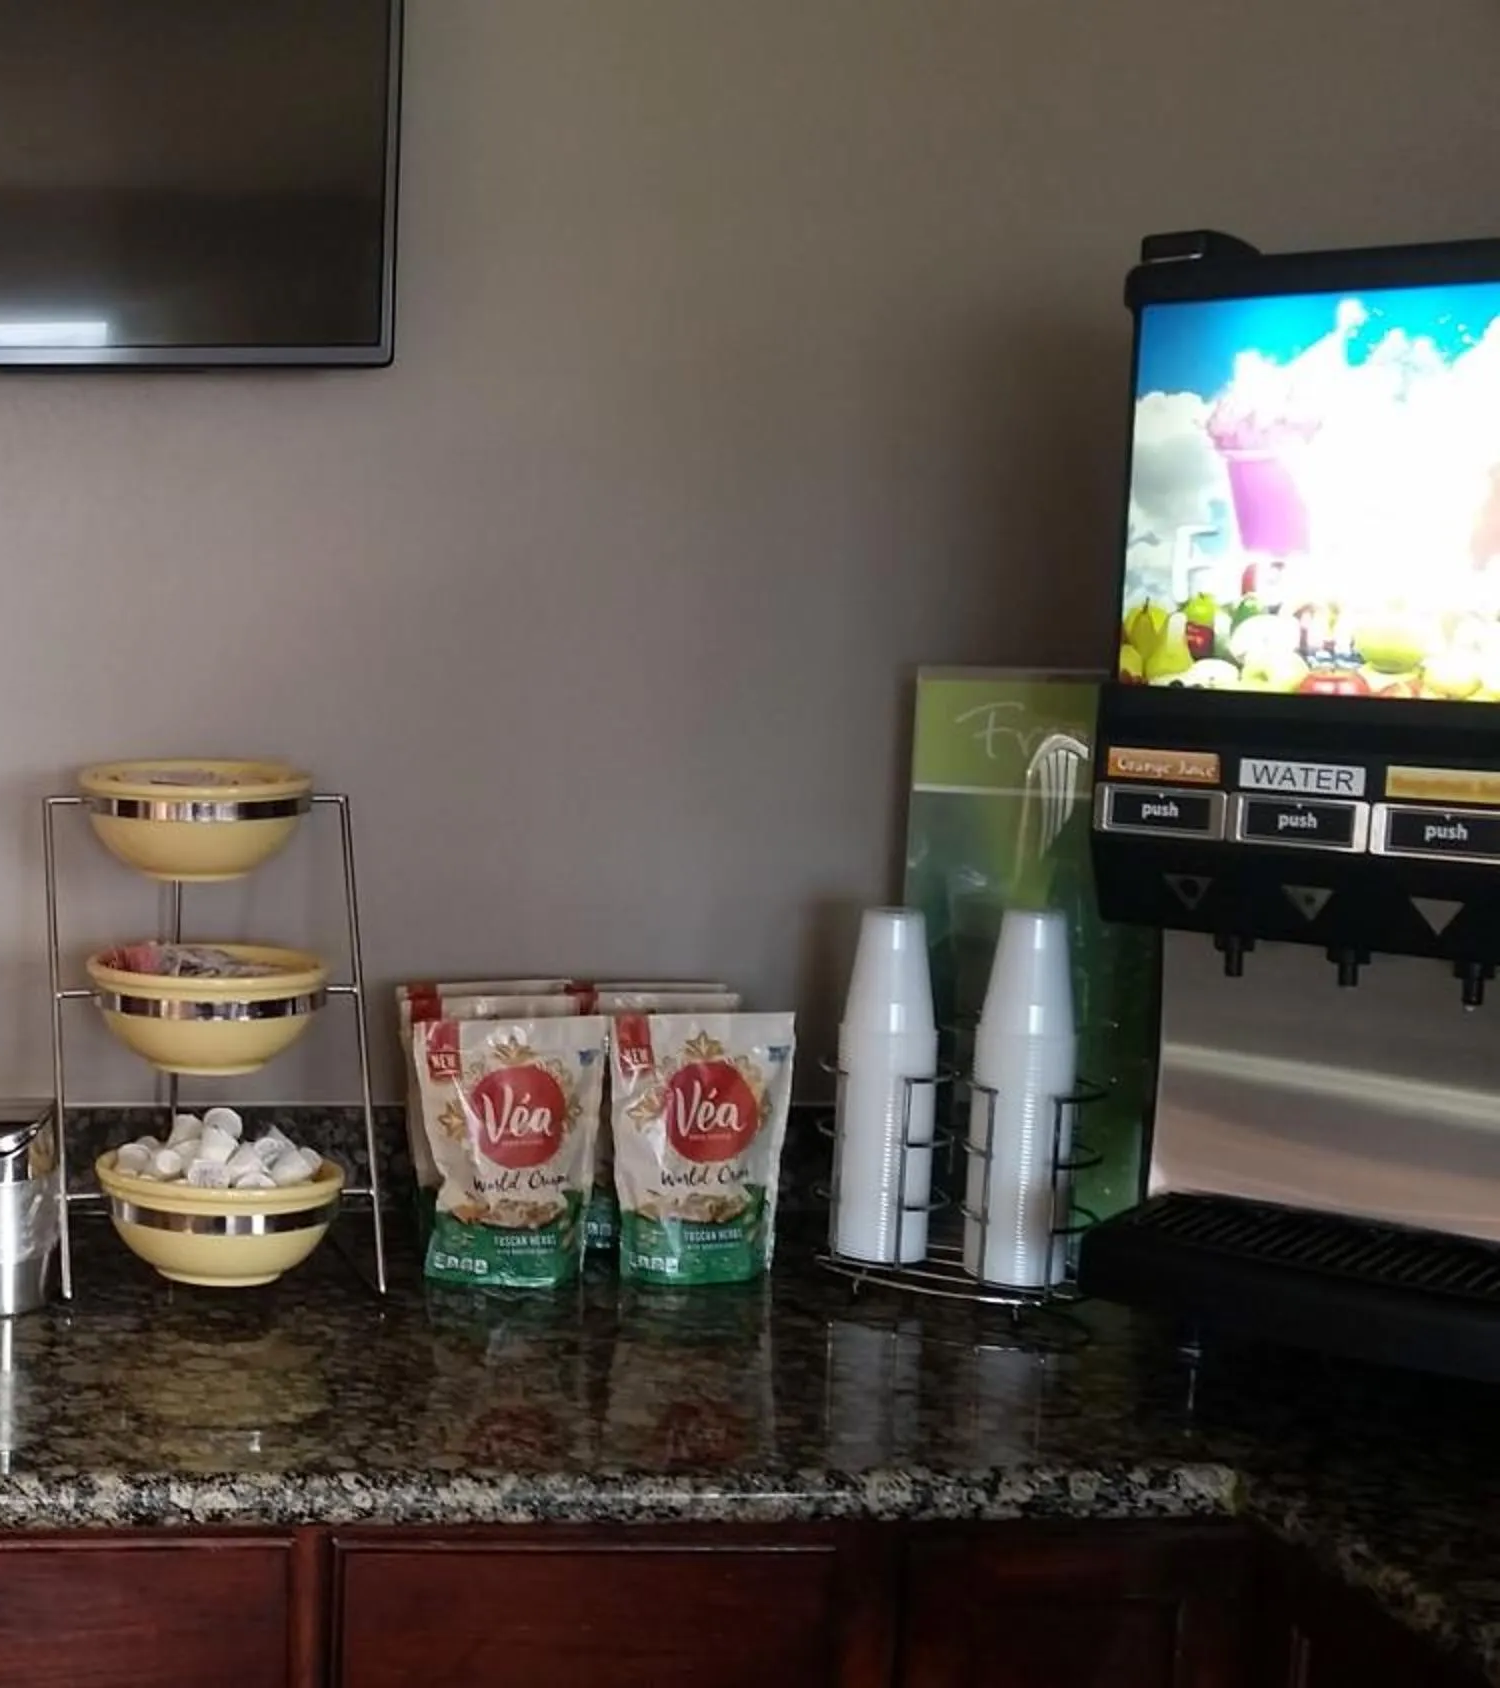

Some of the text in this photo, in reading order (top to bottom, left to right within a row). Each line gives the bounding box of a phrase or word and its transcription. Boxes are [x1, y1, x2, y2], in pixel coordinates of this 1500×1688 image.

[1117, 757, 1217, 780] Orange Juice
[1252, 763, 1354, 791] WATER
[1141, 801, 1180, 819] push
[1278, 812, 1318, 830] push
[1424, 822, 1469, 842] push
[481, 1084, 553, 1144] Véa
[675, 1080, 746, 1137] Véa
